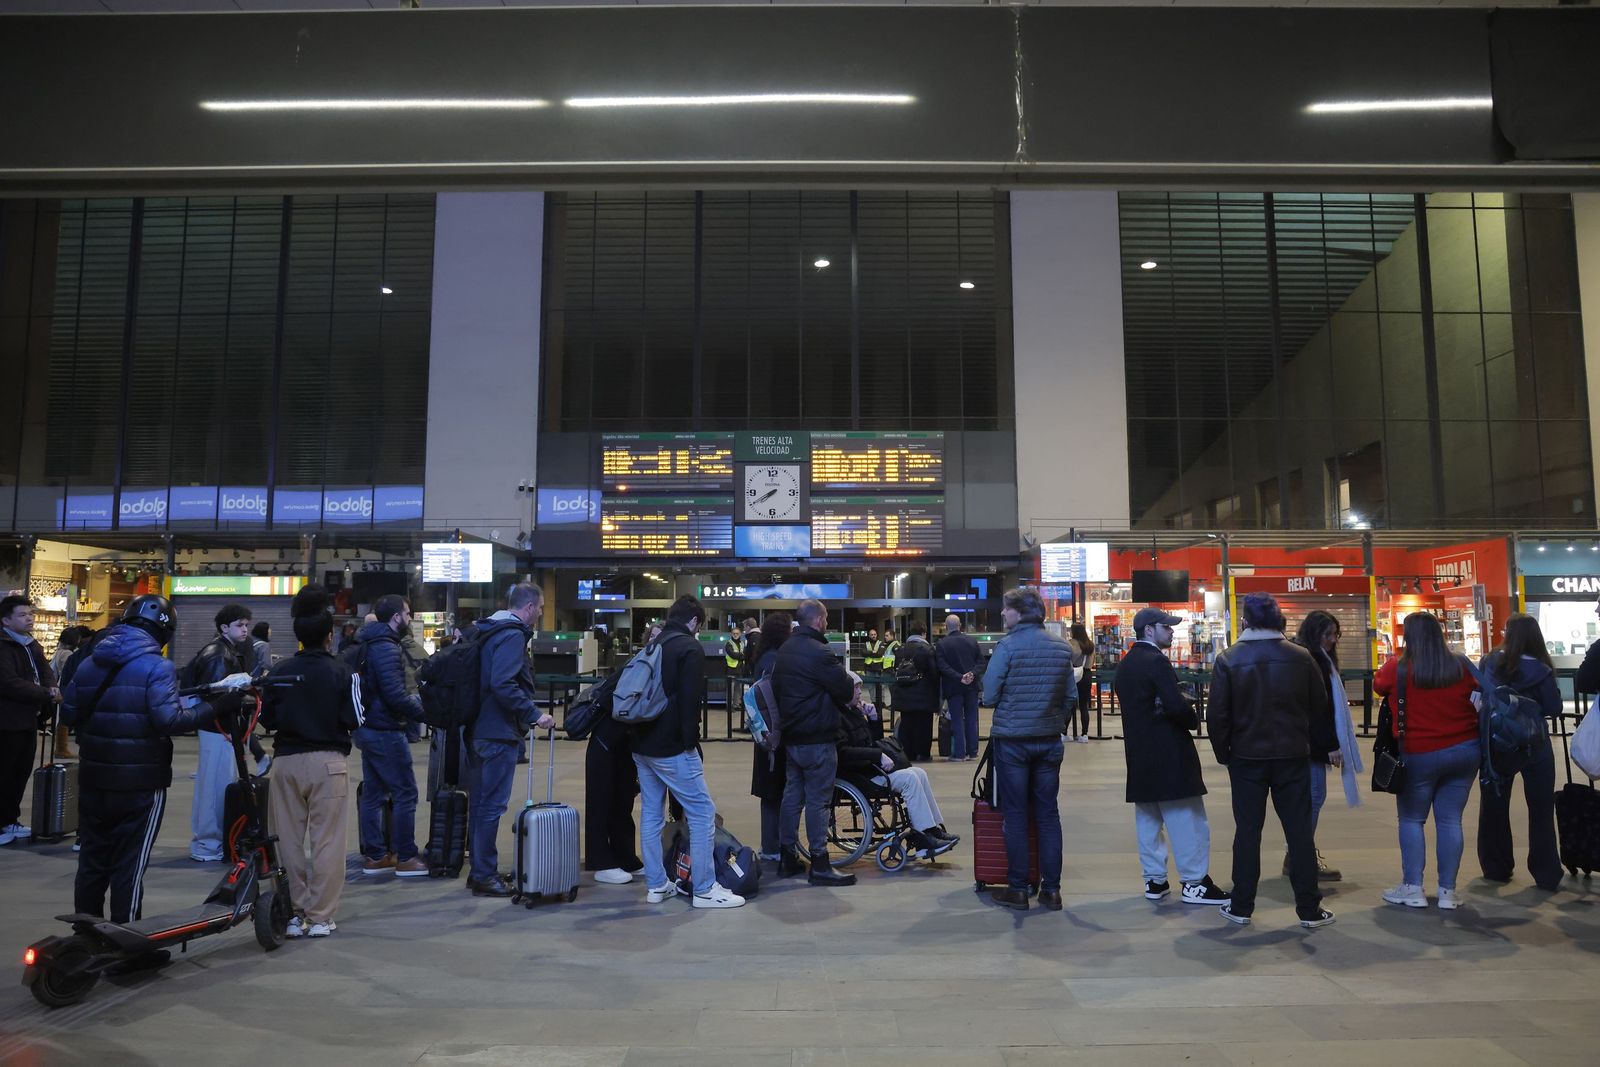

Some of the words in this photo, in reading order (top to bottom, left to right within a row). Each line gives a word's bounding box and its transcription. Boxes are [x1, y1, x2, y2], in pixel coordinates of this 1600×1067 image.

[752, 436, 776, 445] TRENES
[777, 436, 793, 444] ALTA
[755, 446, 790, 455] VELOCIDAD
[770, 532, 792, 541] SPEED
[761, 542, 784, 551] TRAINS
[1288, 577, 1315, 592] RELAY
[1552, 577, 1600, 593] CHAN
